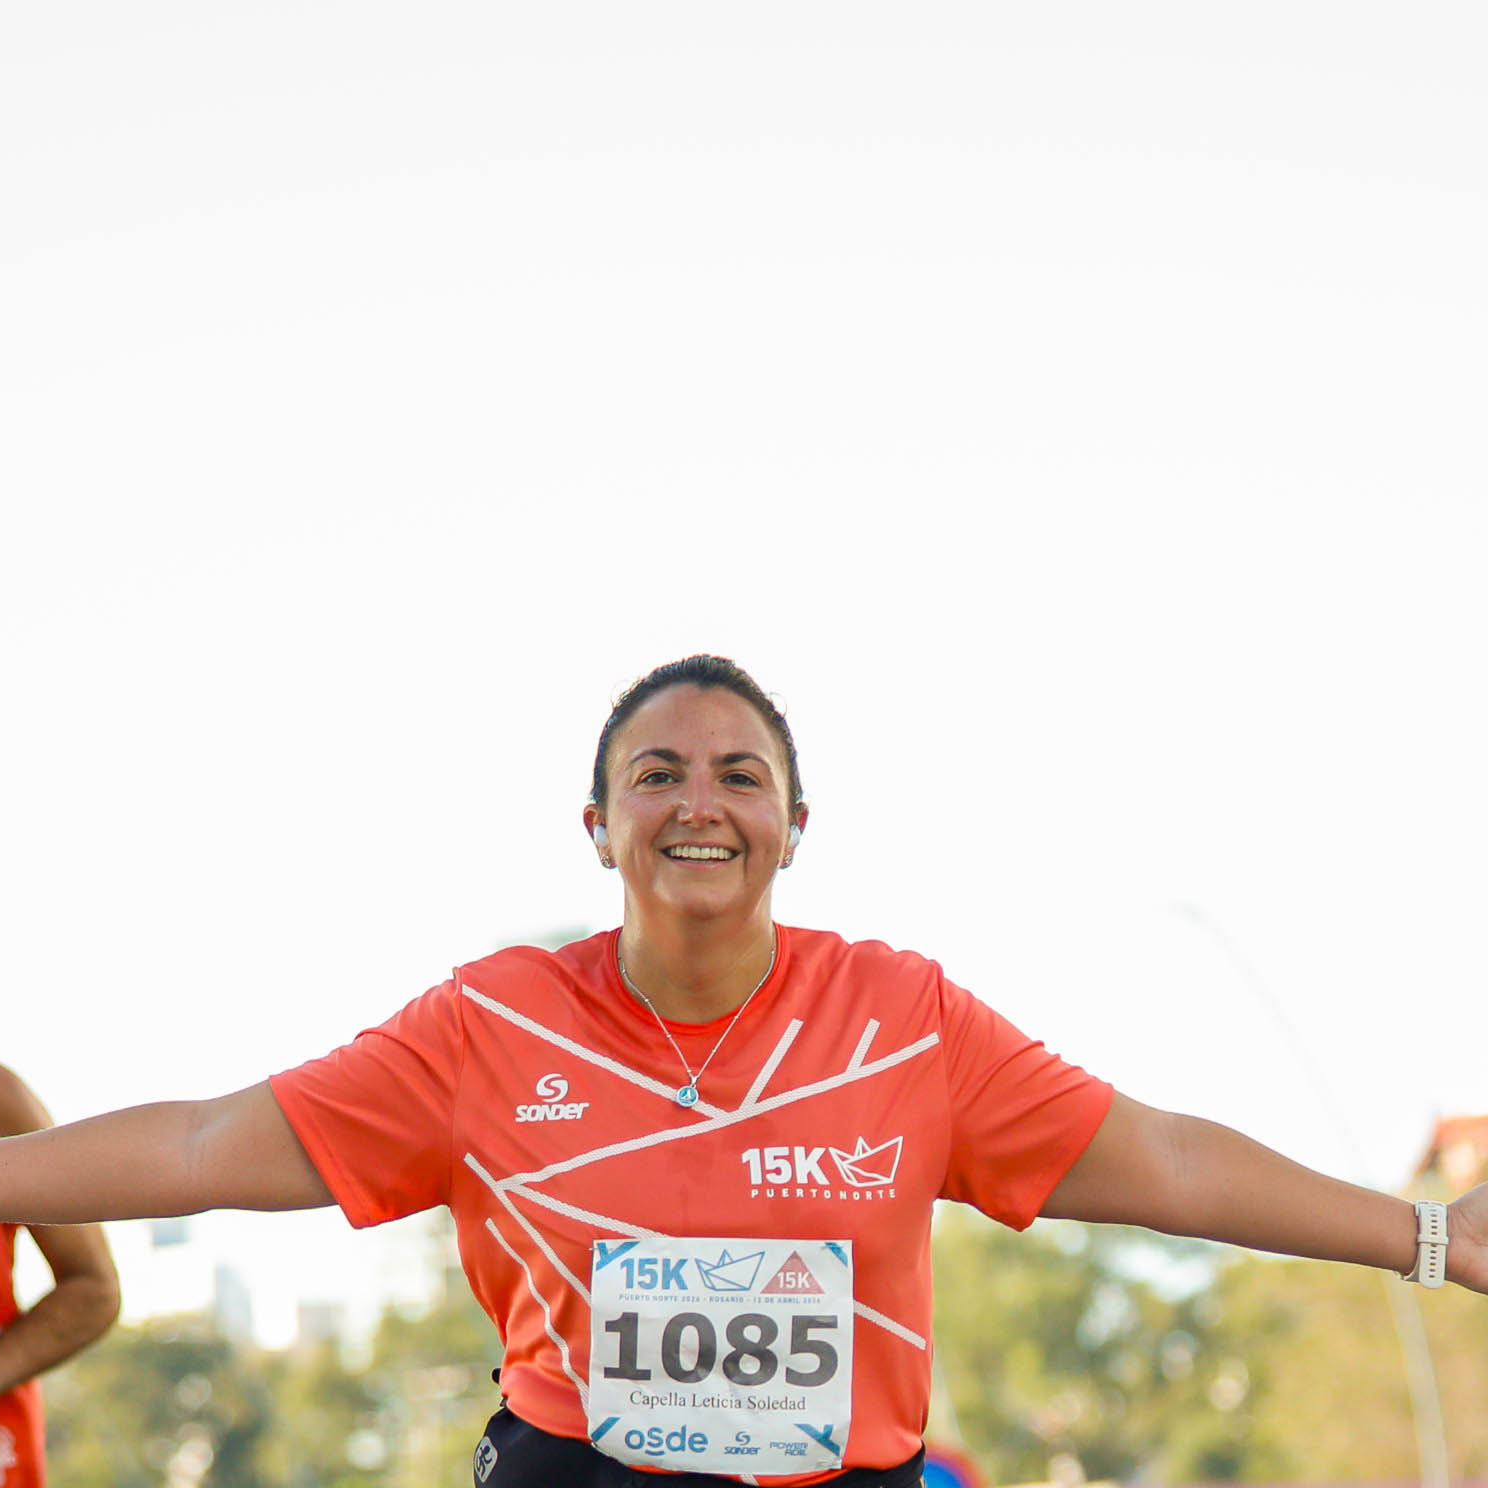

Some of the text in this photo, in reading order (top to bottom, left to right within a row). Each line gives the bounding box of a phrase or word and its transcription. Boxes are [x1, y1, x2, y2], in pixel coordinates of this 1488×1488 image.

[741, 1146, 830, 1185] 15K
[751, 1188, 897, 1200] PUERTO NORTE
[620, 1258, 688, 1290] 15K
[777, 1271, 811, 1289] 15K
[604, 1312, 838, 1387] 1085
[630, 1391, 806, 1410] Capella Leticia Soledad
[625, 1424, 708, 1455] osde
